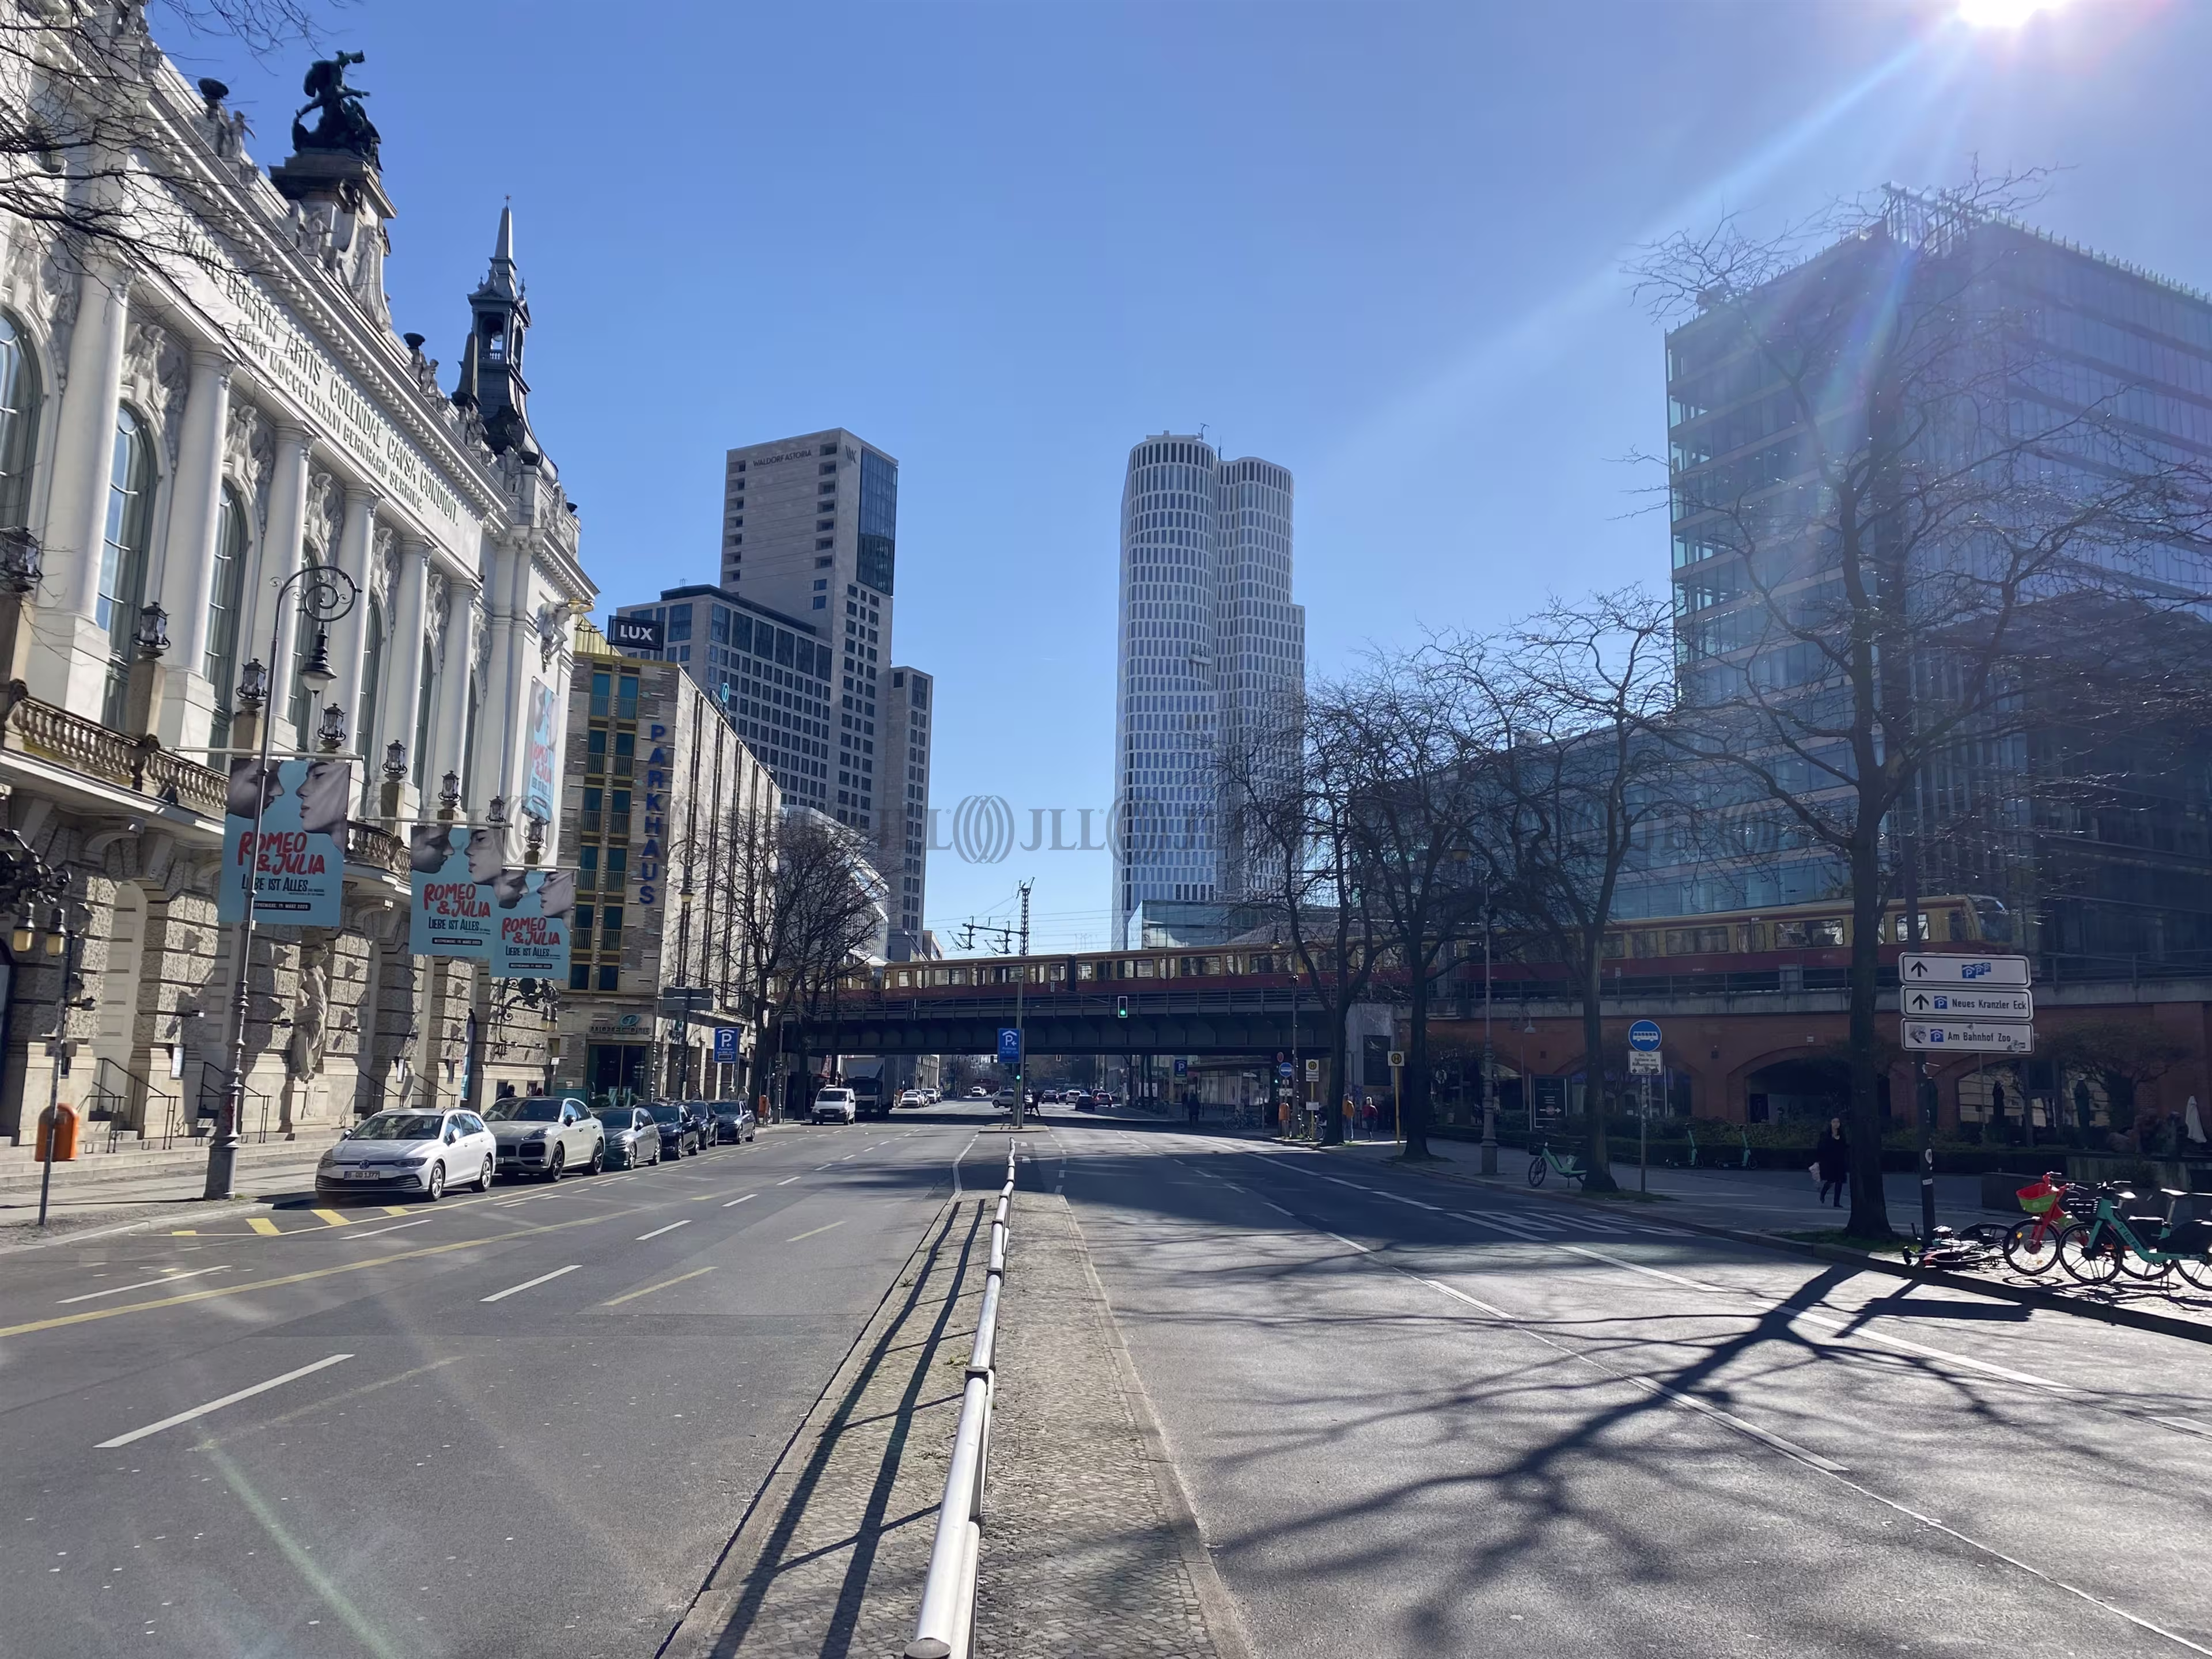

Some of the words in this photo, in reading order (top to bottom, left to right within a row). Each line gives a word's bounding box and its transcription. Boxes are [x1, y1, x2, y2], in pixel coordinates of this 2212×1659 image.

[285, 331, 321, 387] ARTIS
[329, 376, 383, 448] COLENDAE
[387, 435, 416, 484] CAVSA
[343, 423, 387, 479] BERNHARD
[753, 455, 784, 467] WALDORF
[785, 449, 812, 461] ASTORIA
[620, 624, 653, 641] LUX
[639, 724, 666, 904] PARKHAUS
[268, 878, 282, 892] IST
[282, 877, 309, 892] ALLES
[423, 883, 476, 911] ROMEO
[429, 916, 446, 930] LIEBE
[448, 919, 459, 930] IST
[460, 919, 480, 931] ALLES
[501, 917, 547, 941] ROMEO
[505, 945, 521, 956] LIEBE
[522, 948, 532, 956] IST
[532, 946, 550, 957] ALLES
[1952, 998, 1975, 1008] Neues
[1979, 999, 2010, 1009] Kranzler
[2013, 1001, 2027, 1010] Eck
[721, 1033, 732, 1047] P
[1005, 1035, 1013, 1046] P
[1948, 1032, 1960, 1041] Am
[1963, 1032, 1994, 1042] Bahnhof
[1998, 1033, 2012, 1042] Zoo
[2118, 1224, 2140, 1251] TIER
